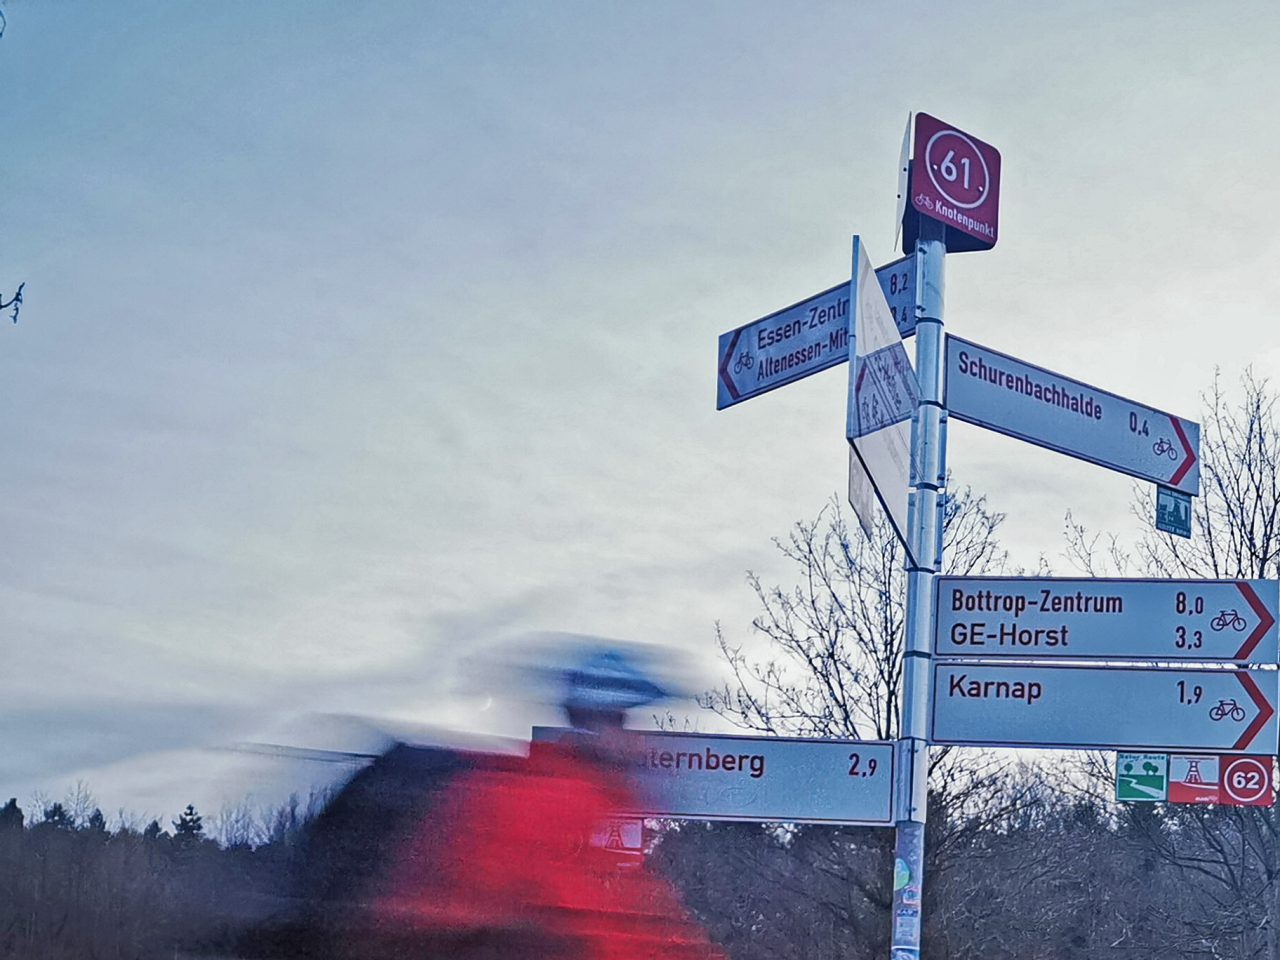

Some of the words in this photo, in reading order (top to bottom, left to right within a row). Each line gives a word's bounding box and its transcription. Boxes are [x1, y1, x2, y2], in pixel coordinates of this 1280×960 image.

[940, 150, 970, 190] 61
[935, 199, 995, 238] Knotenpunkt
[757, 298, 849, 350] Essen-Zentr
[757, 329, 849, 381] Altenessen-Mit
[958, 351, 1103, 420] Schurenbachhalde
[951, 588, 1123, 618] Bottrop-Zentrum
[1175, 591, 1204, 616] 8,0
[950, 623, 1069, 646] GE-Horst
[1175, 626, 1202, 650] 3,3
[949, 674, 1042, 705] Karnap
[1177, 680, 1202, 705] 1,9
[643, 746, 765, 778] ternberg
[848, 752, 877, 778] 2,9
[1232, 772, 1260, 789] 62
